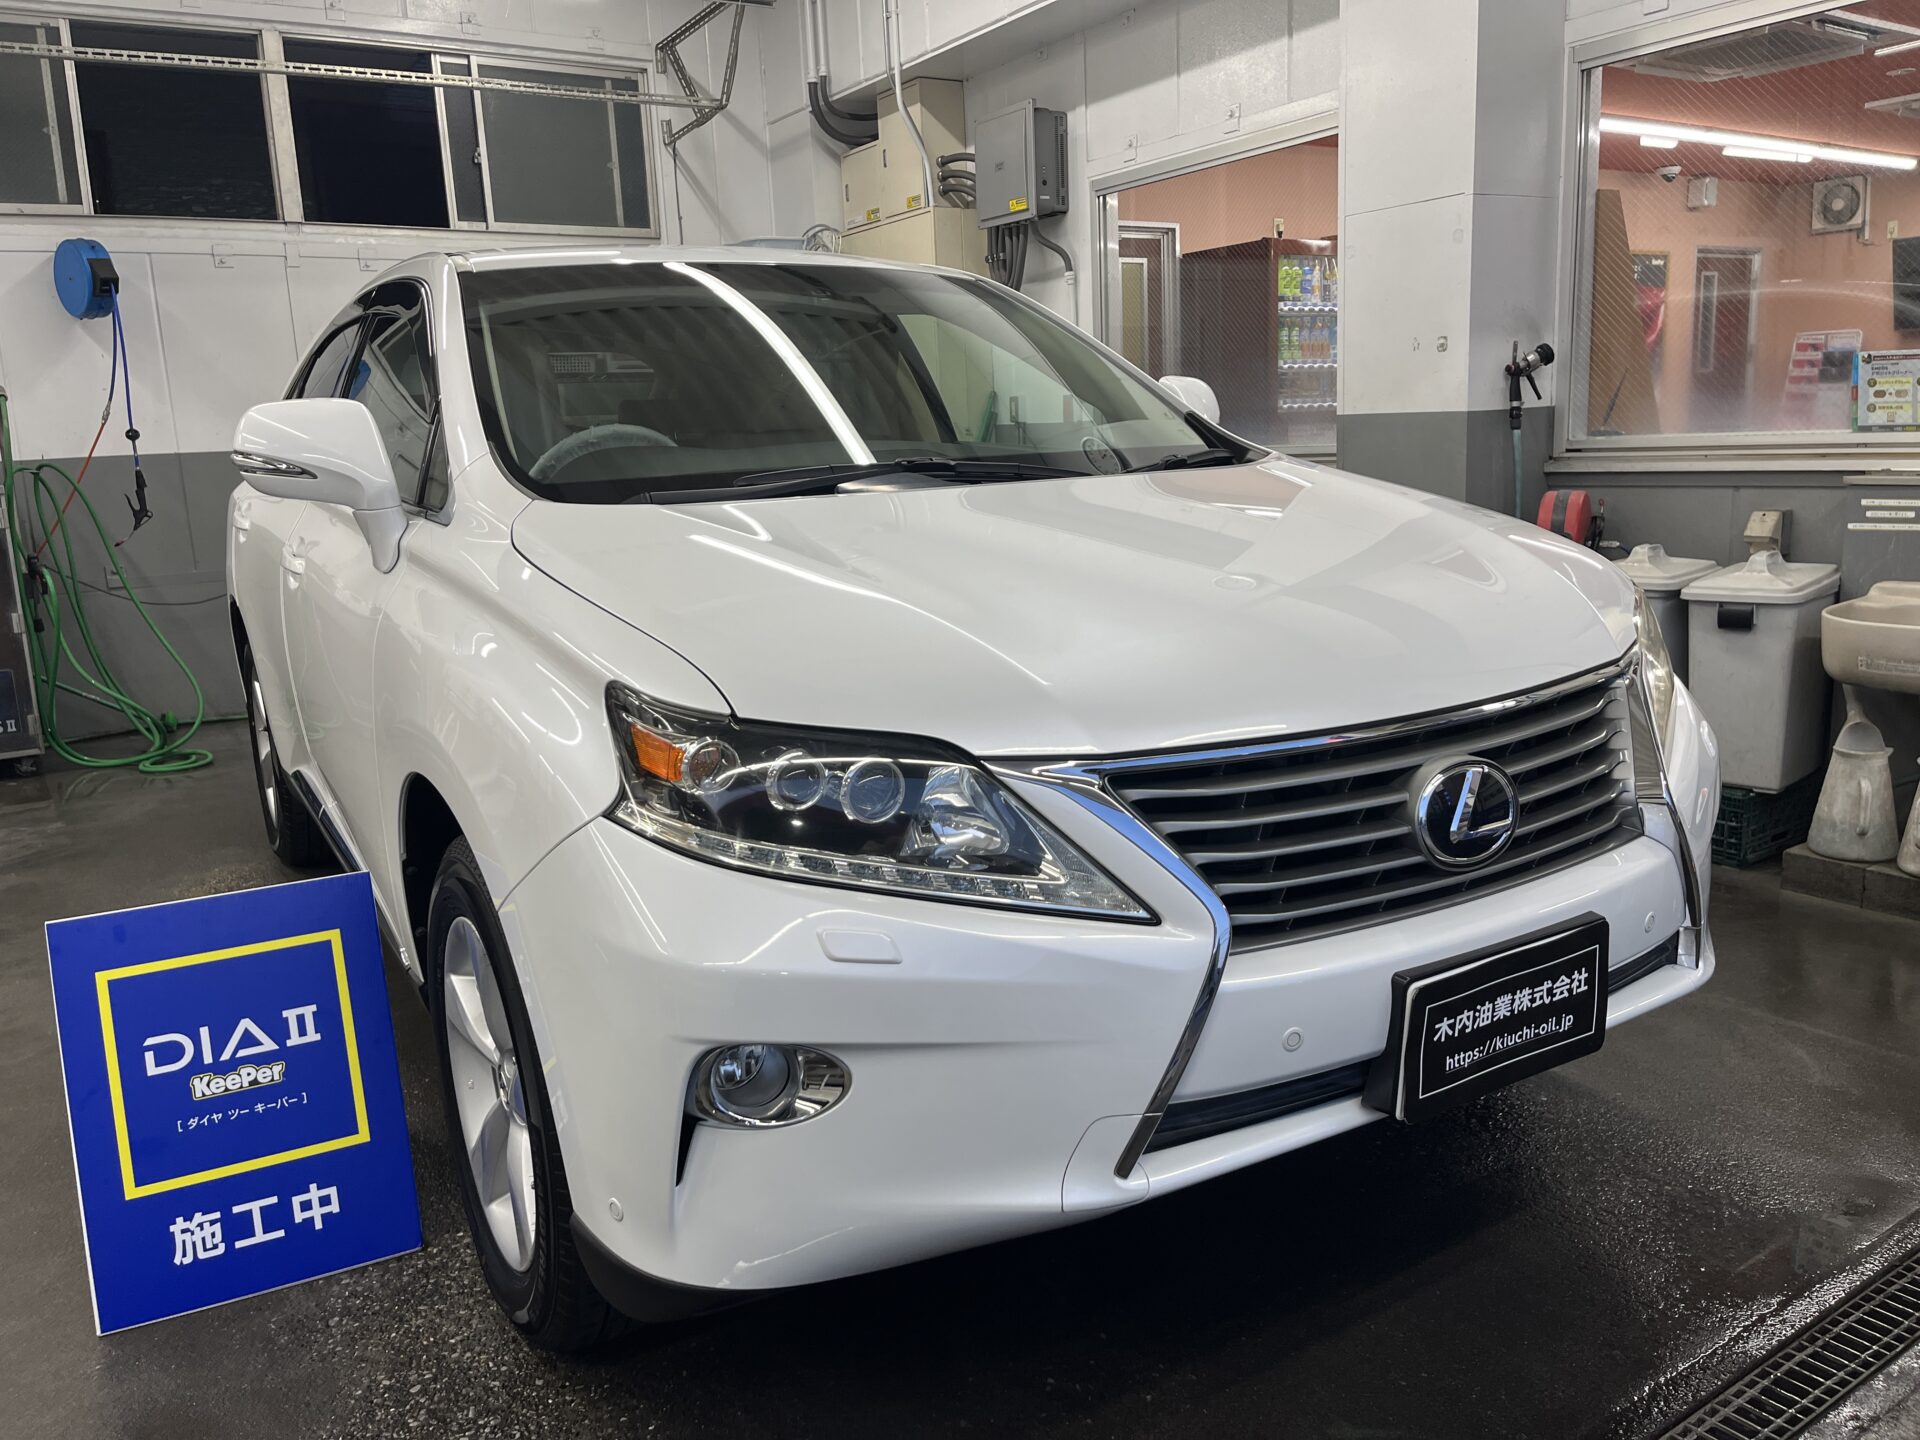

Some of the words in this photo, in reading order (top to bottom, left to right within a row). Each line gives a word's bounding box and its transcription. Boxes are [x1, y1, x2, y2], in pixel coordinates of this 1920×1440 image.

[1433, 967, 1589, 1044] 木内油業株式会社
[1445, 1013, 1574, 1071] https://kiuchi-oil.jp
[190, 1061, 285, 1100] KeePer
[169, 1182, 341, 1266] 施工中
